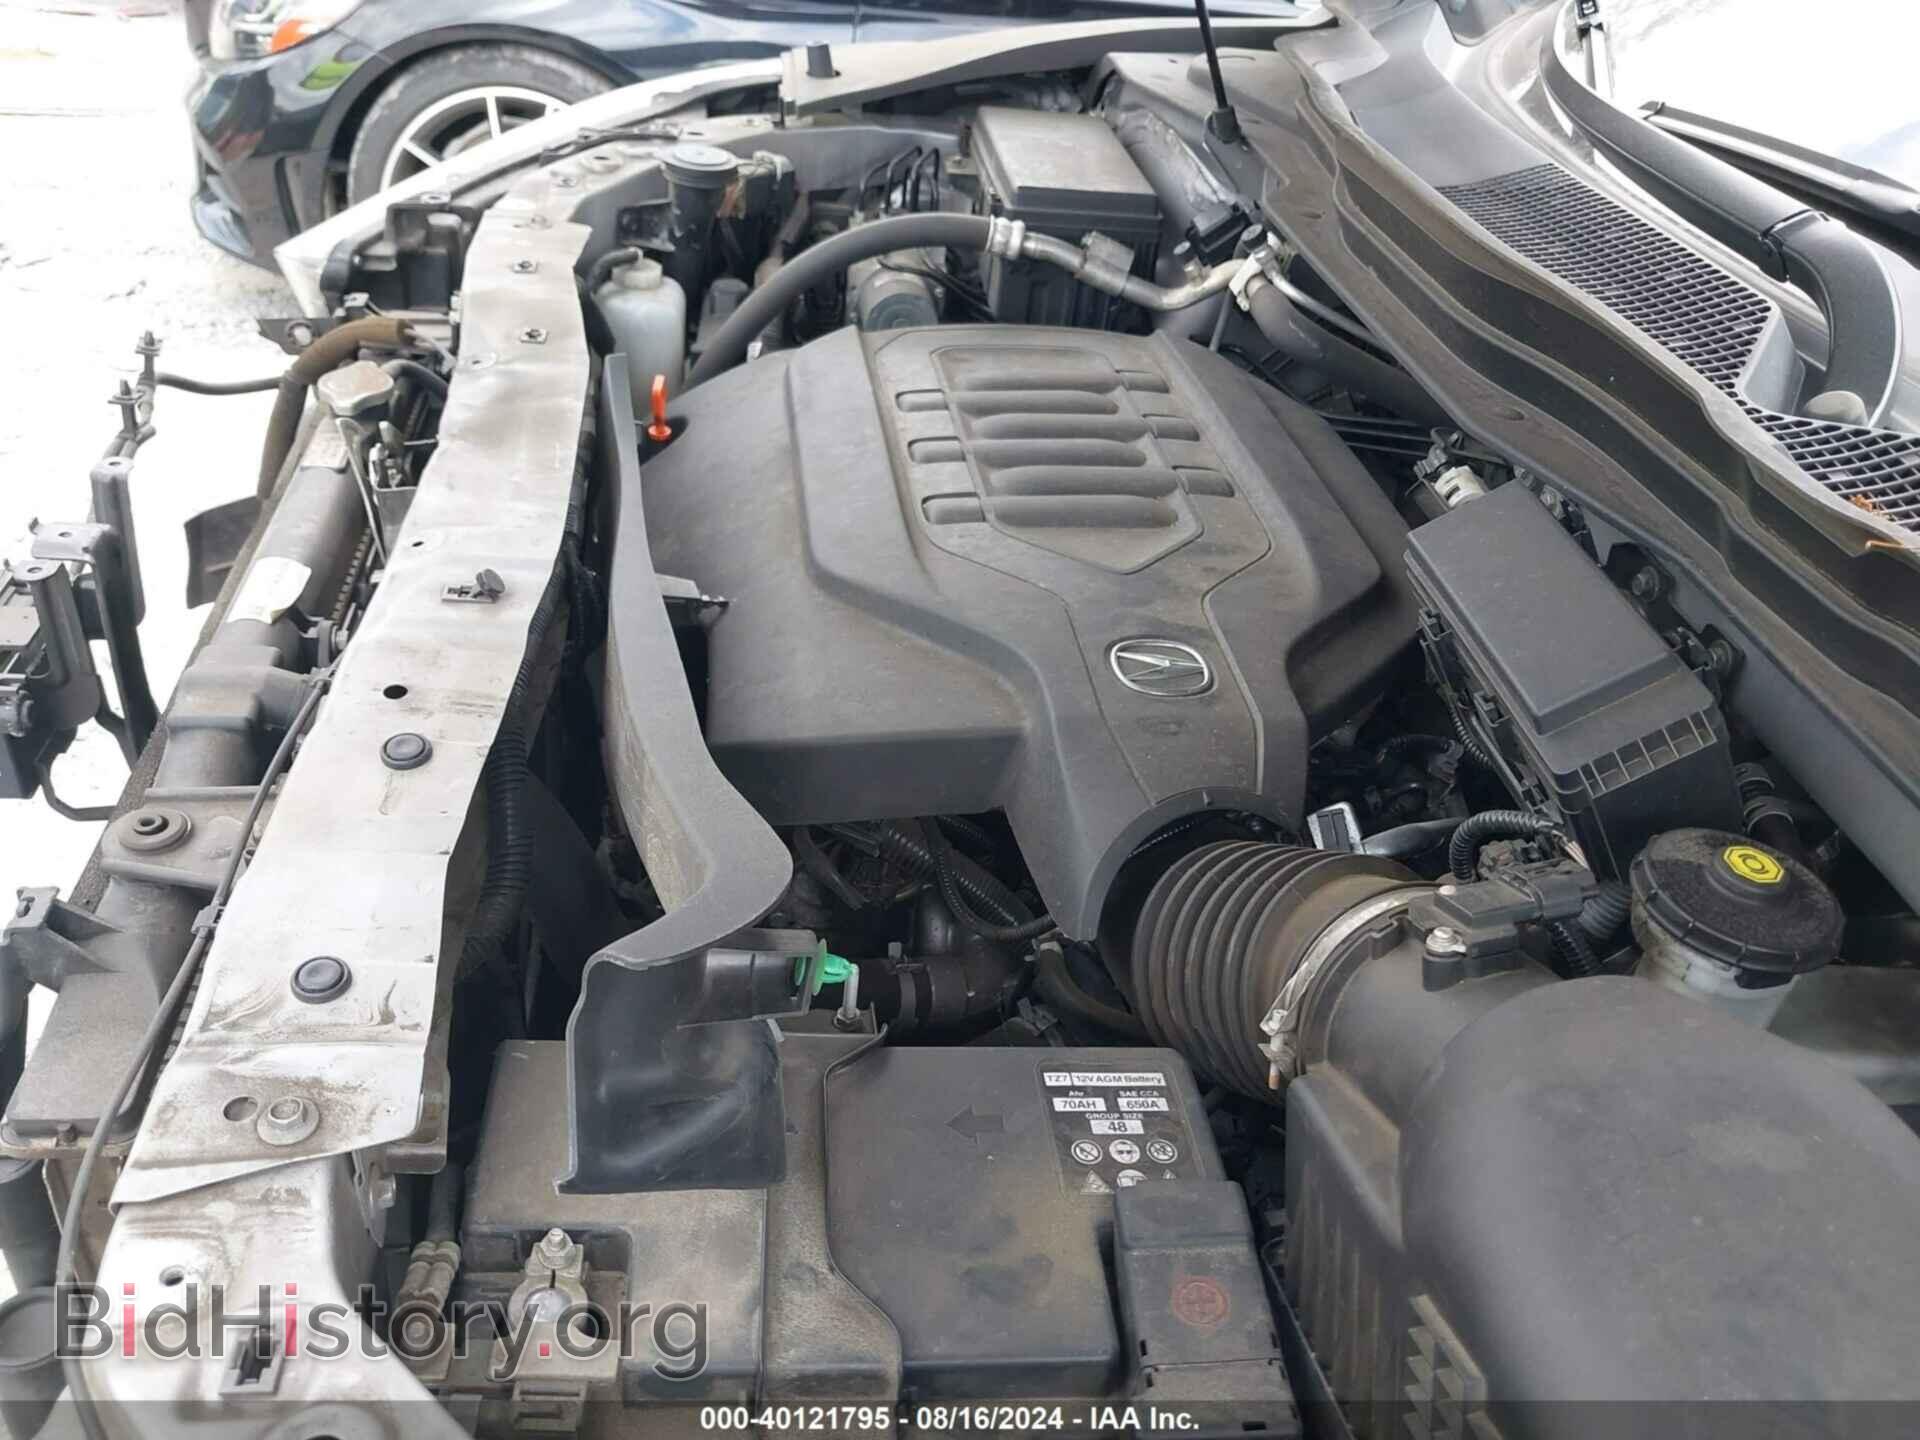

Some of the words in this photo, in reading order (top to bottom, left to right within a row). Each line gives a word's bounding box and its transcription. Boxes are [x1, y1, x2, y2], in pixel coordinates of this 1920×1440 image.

[1124, 1075, 1162, 1084] Battery
[1062, 1100, 1096, 1109] 70AH
[1126, 1100, 1160, 1109] 650A
[1108, 1121, 1128, 1132] 48
